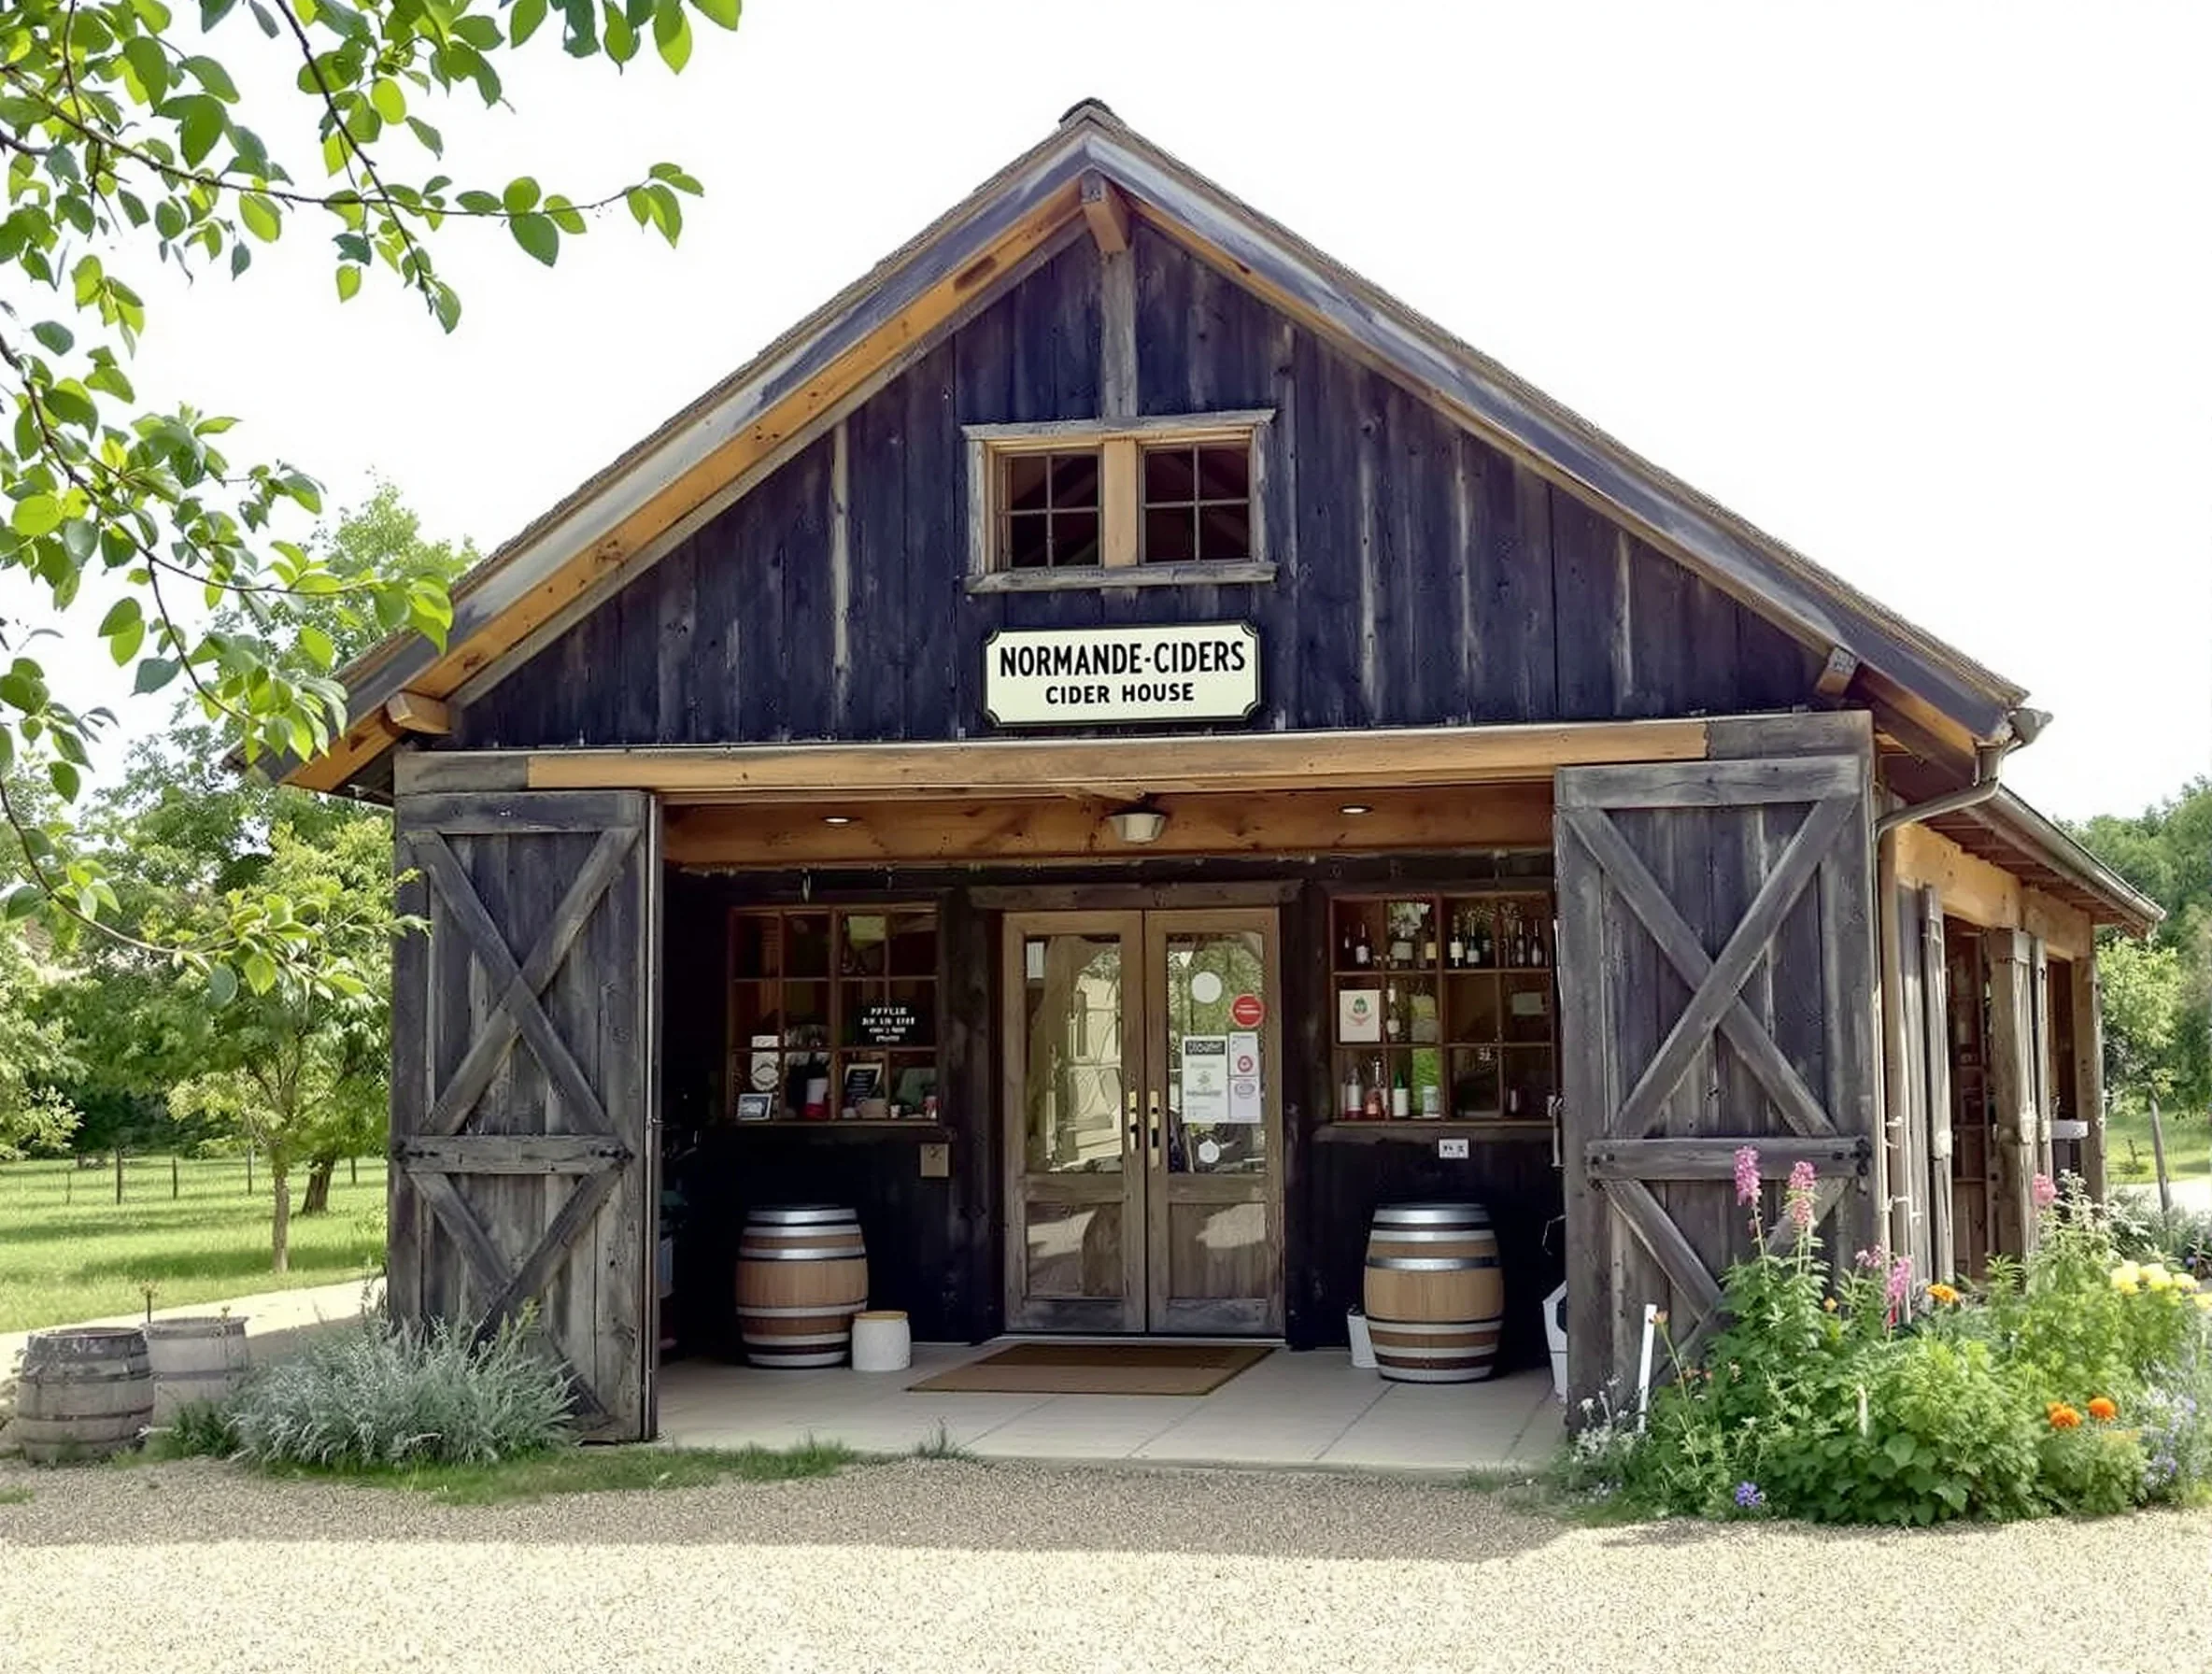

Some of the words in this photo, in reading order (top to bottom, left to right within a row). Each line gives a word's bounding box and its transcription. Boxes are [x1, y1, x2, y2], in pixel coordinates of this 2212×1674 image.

[1000, 641, 1245, 677] NORMANDE-CIDERS
[1045, 686, 1110, 704] CIDER
[1122, 683, 1195, 702] HOUSE
